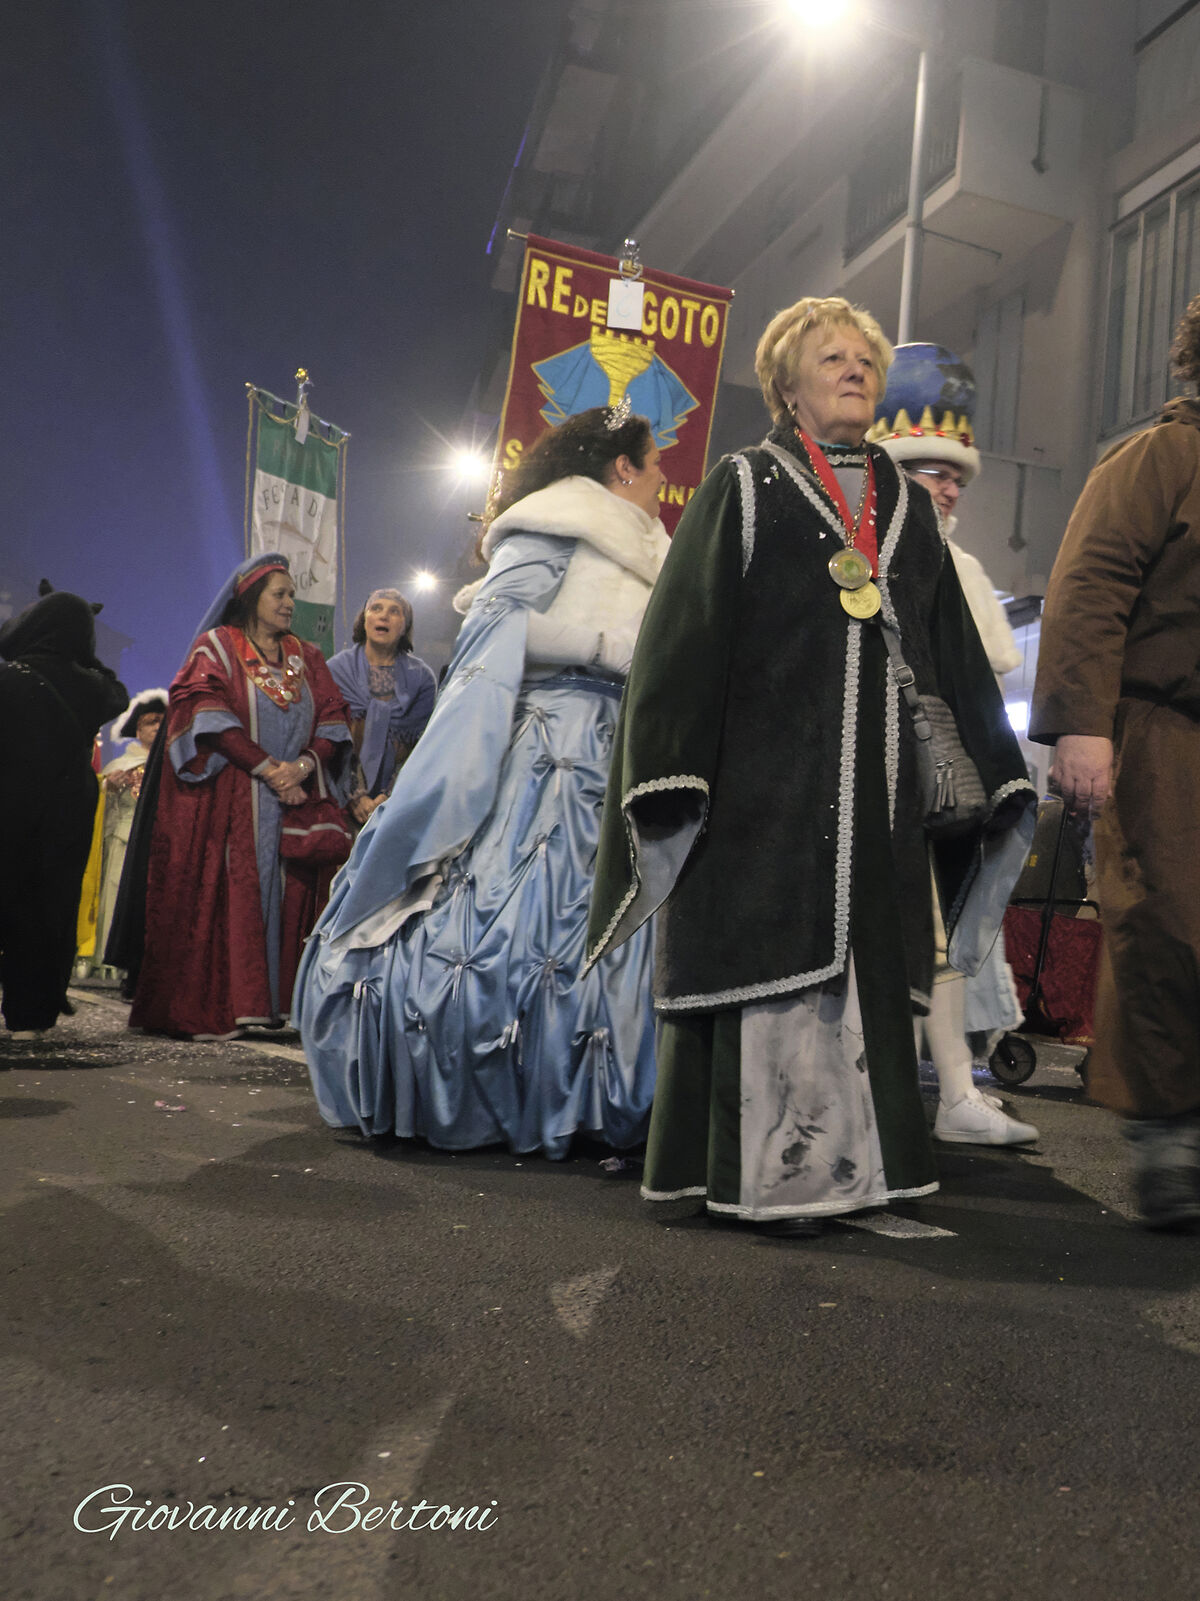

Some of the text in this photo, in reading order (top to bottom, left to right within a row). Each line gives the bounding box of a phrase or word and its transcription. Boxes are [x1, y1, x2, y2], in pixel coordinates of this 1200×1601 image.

[526, 258, 573, 315] RE
[573, 294, 607, 326] DE
[640, 291, 720, 348] GOTO
